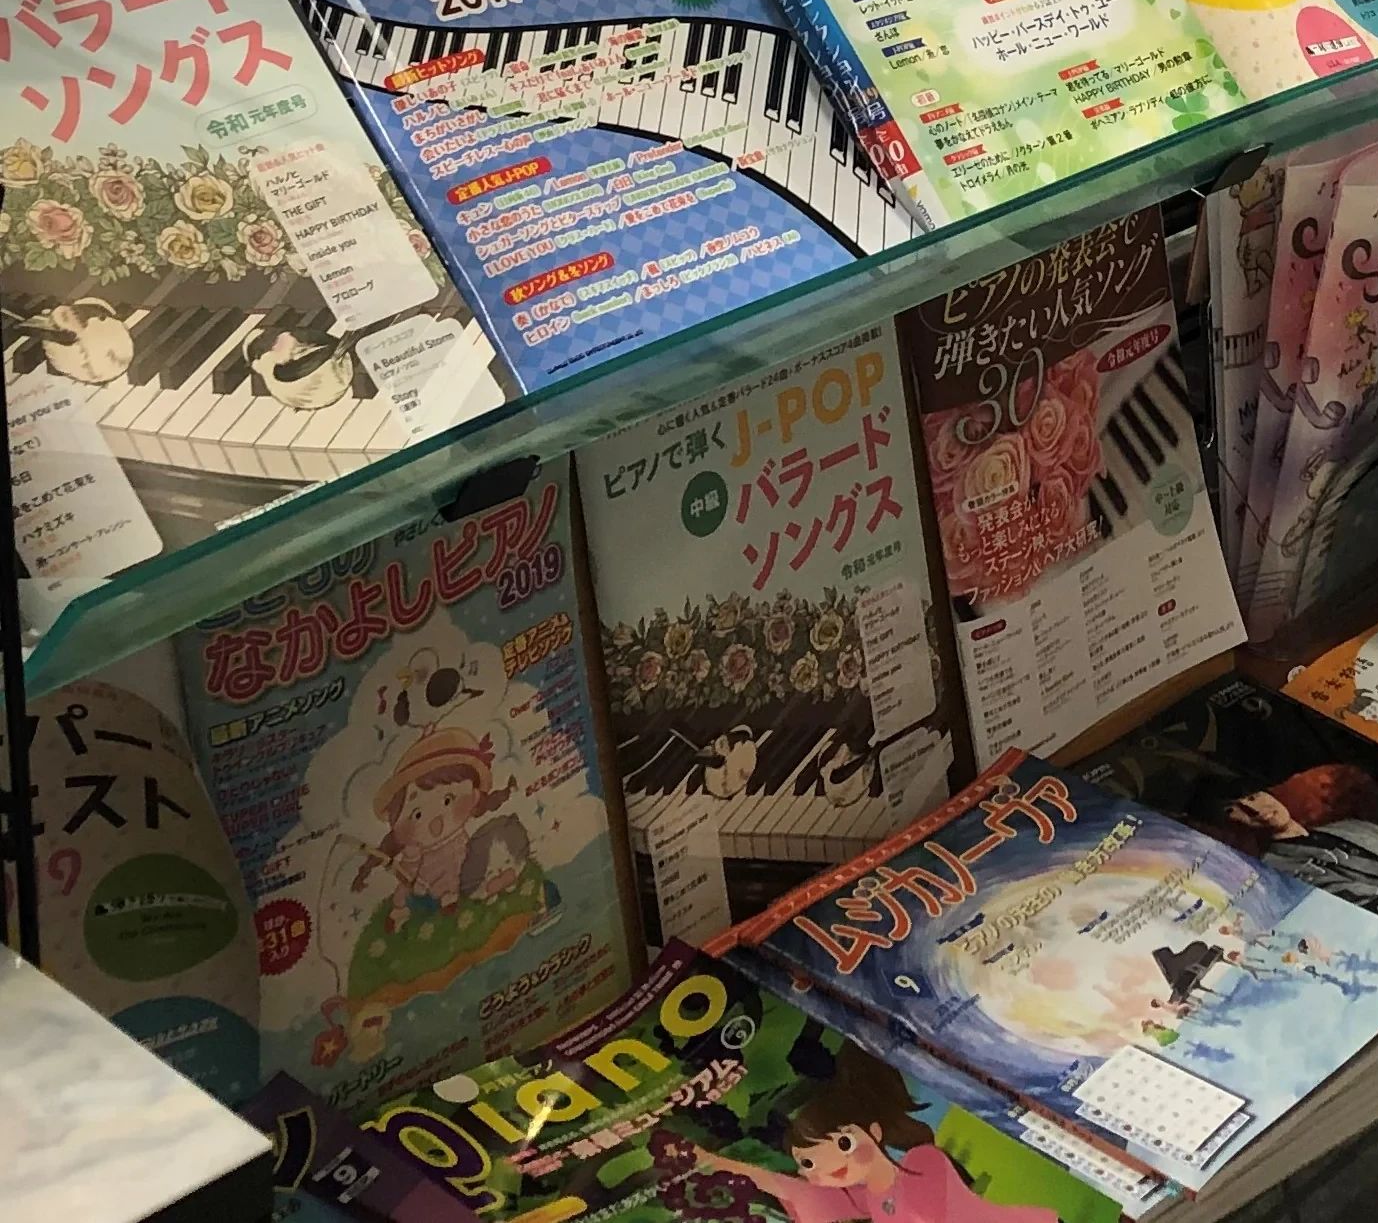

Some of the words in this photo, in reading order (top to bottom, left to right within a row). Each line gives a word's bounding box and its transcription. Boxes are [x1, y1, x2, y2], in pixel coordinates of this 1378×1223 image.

[996, 13, 1110, 61] ホール・ニュー・ワールド
[20, 20, 293, 144] ソングス
[1073, 86, 1105, 104] HAPPY
[1107, 68, 1150, 93] BIRTHDAY
[412, 110, 487, 145] まちがいさがし
[422, 134, 477, 162] 会いたいよ
[456, 161, 539, 201] 定番人気J-POP
[282, 204, 304, 220] THE
[296, 220, 329, 241] HAPPY
[330, 202, 380, 228] BIRTHDAY
[468, 205, 543, 242] 小さな恋のうた
[477, 197, 620, 259] シュガーソングとビターステップ
[332, 280, 374, 304] プロローグ
[944, 214, 1140, 324] ピアノの発表会で
[524, 317, 569, 345] ヒロイン
[934, 233, 1158, 380] 弾きたい人気ソング
[730, 352, 885, 469] J-POP
[955, 347, 1044, 445] 30
[603, 422, 726, 499] ピアノで弾く
[736, 406, 891, 524] バラード
[23, 512, 75, 544] ハナミズキ
[689, 490, 720, 517] 中級
[977, 493, 1036, 534] 発表会が
[743, 476, 903, 591] ソングス
[959, 501, 1060, 564] もっと楽しみになる
[984, 528, 1053, 576] ステージ映え
[500, 546, 562, 609] 2019
[964, 515, 1104, 605] ファッション&ヘア大研究!
[203, 482, 559, 702] なかよしピアノ
[505, 626, 573, 679] テレビソング
[793, 775, 1078, 974] ムジカノーヴァ
